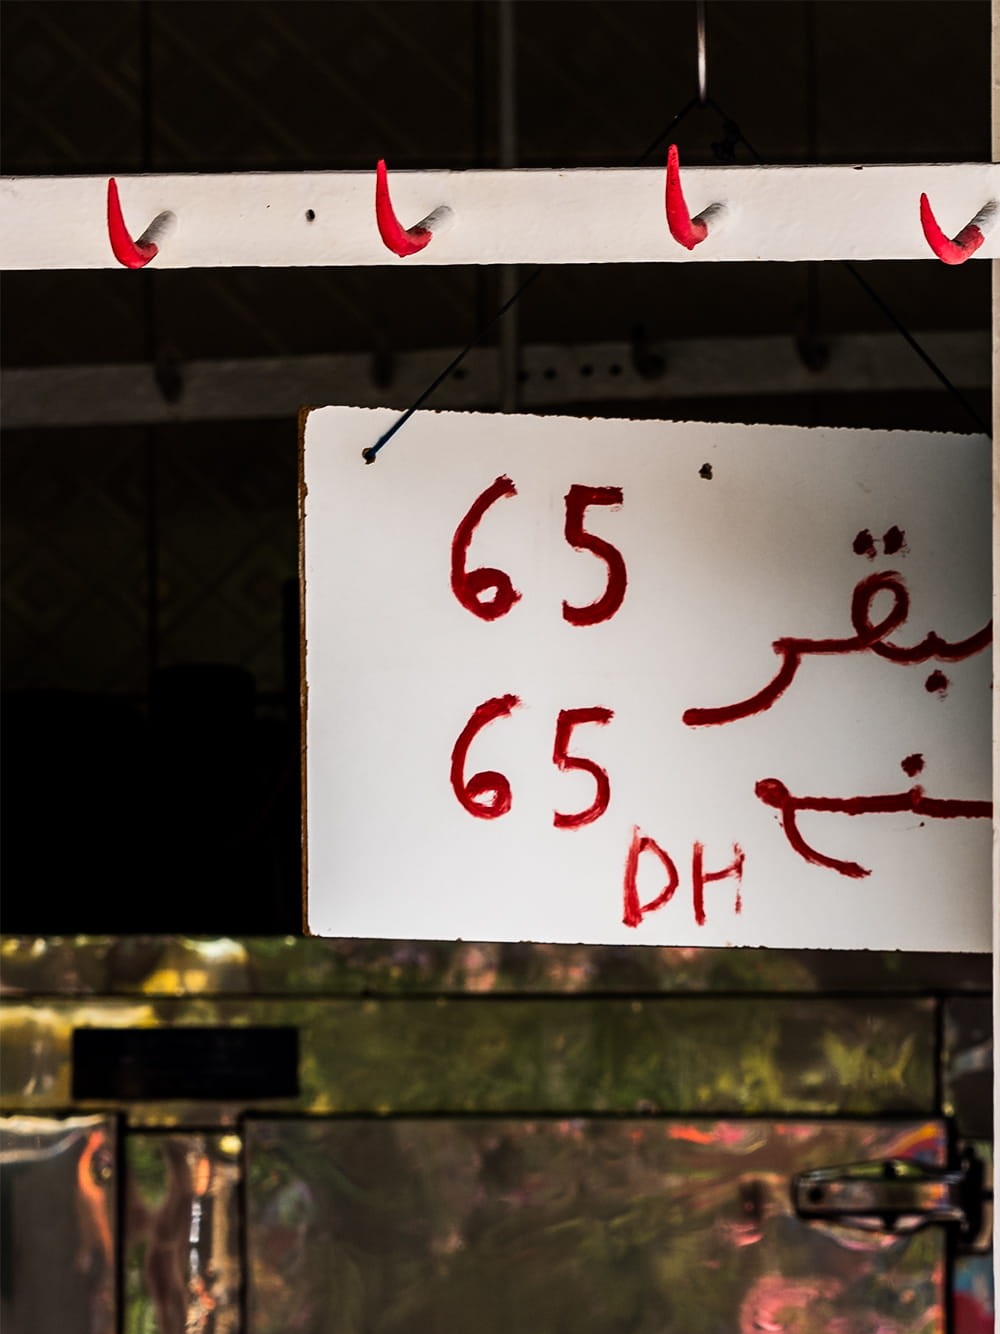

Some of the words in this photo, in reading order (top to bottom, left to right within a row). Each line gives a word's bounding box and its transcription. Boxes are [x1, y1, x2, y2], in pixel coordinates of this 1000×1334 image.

[449, 474, 629, 628] 65
[449, 692, 617, 831] 65
[622, 825, 746, 928] DH
